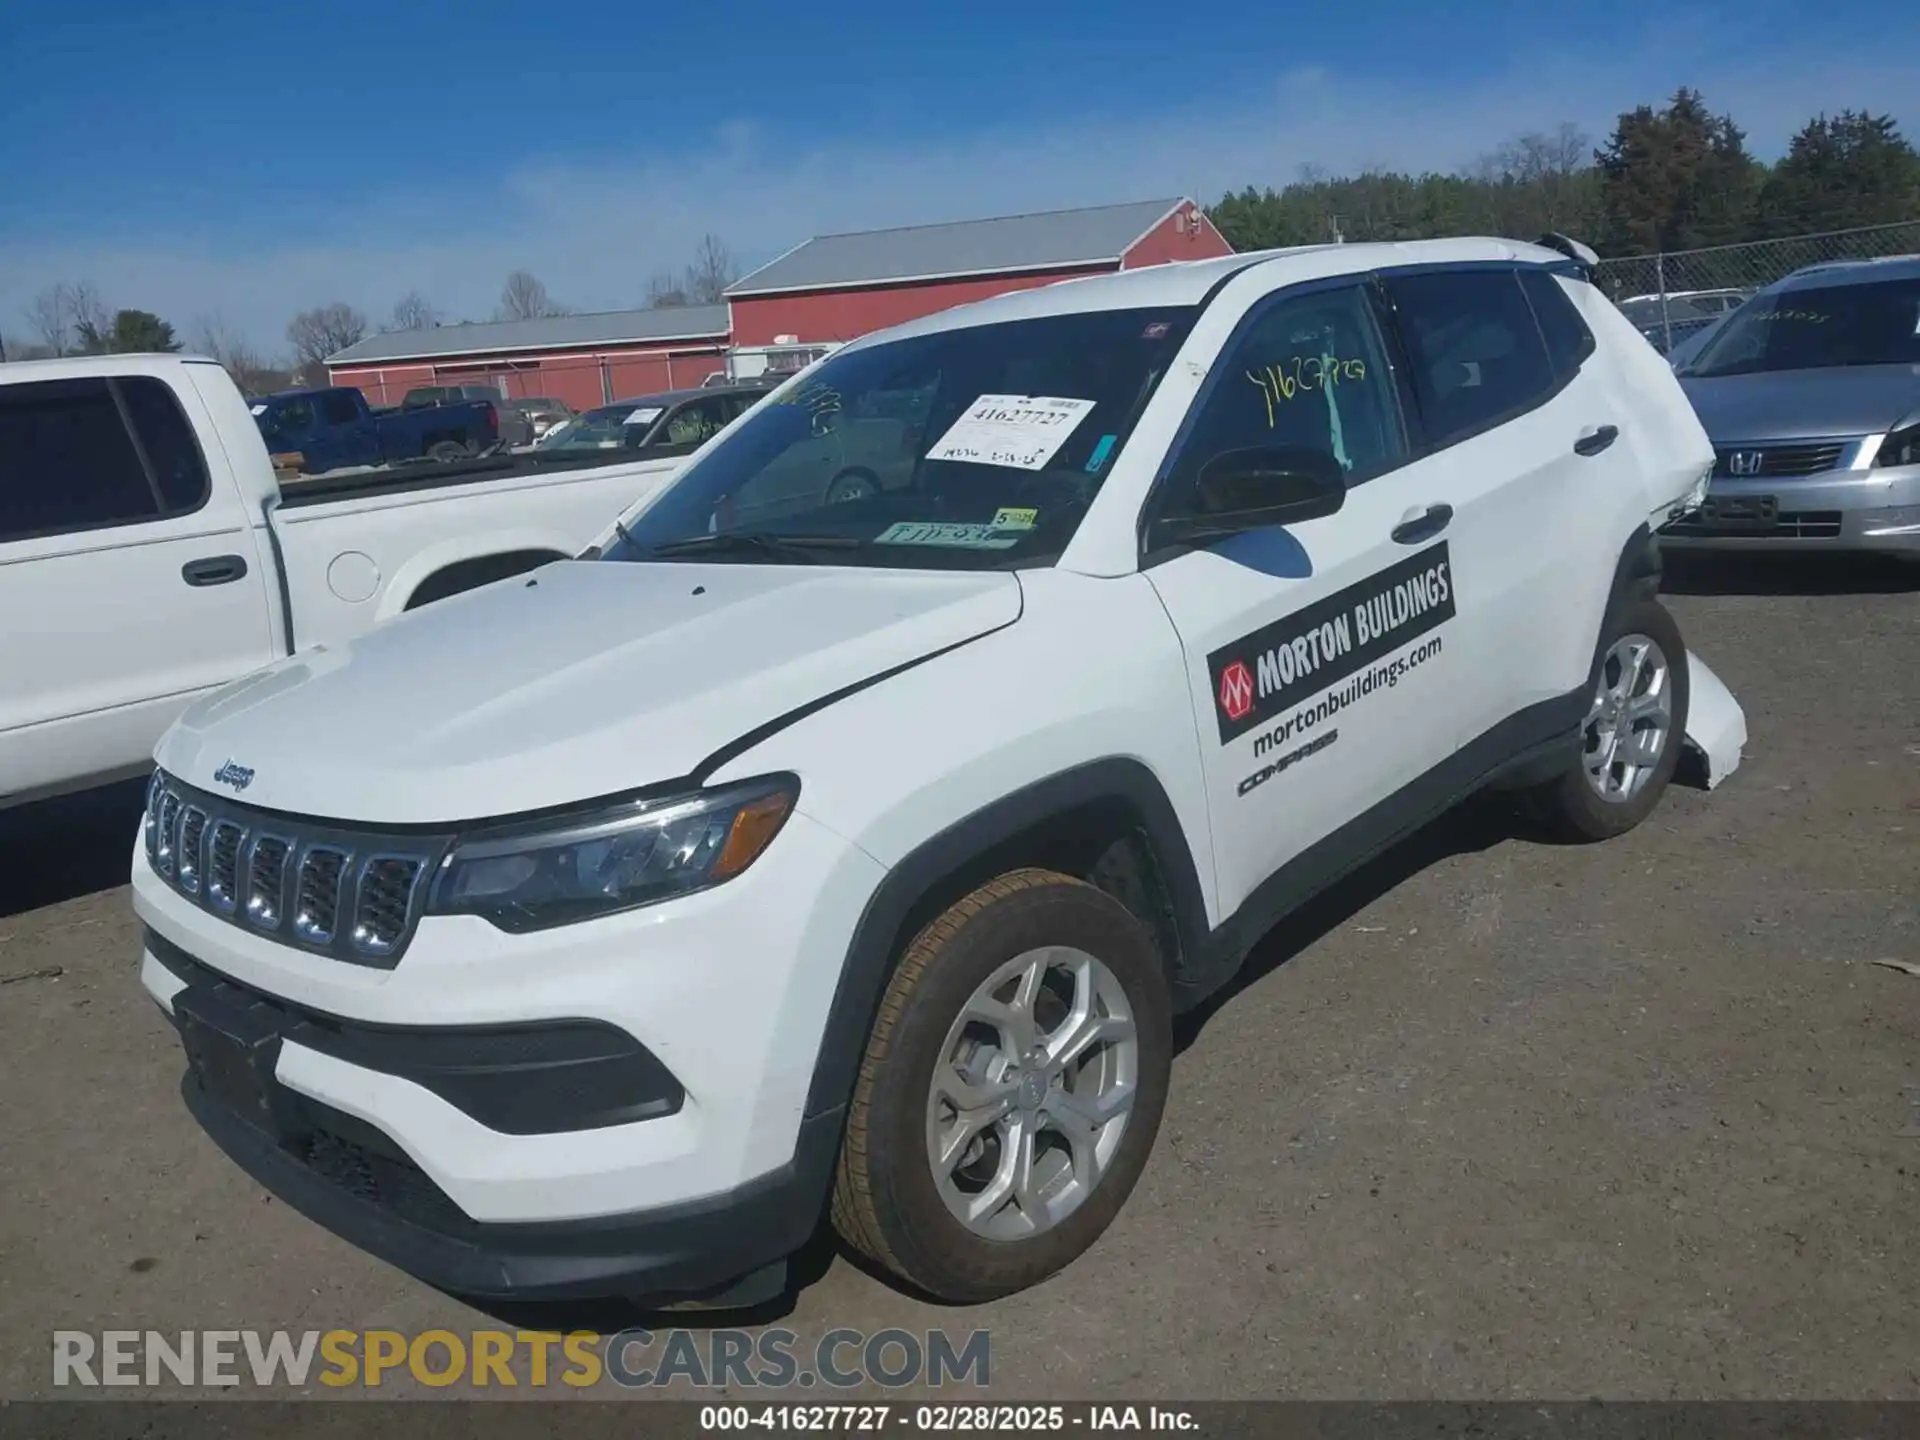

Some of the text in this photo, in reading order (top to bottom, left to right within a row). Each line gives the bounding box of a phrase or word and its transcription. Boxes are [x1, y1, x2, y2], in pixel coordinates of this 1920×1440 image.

[973, 407, 1069, 426] 41627727
[996, 512, 1010, 524] 5
[1257, 612, 1352, 698] MORTON
[1354, 562, 1449, 646] BUILDINGS
[1254, 636, 1443, 758] mortonbuildings.com
[214, 758, 255, 793] Jeep
[1237, 728, 1338, 797] COMPASS
